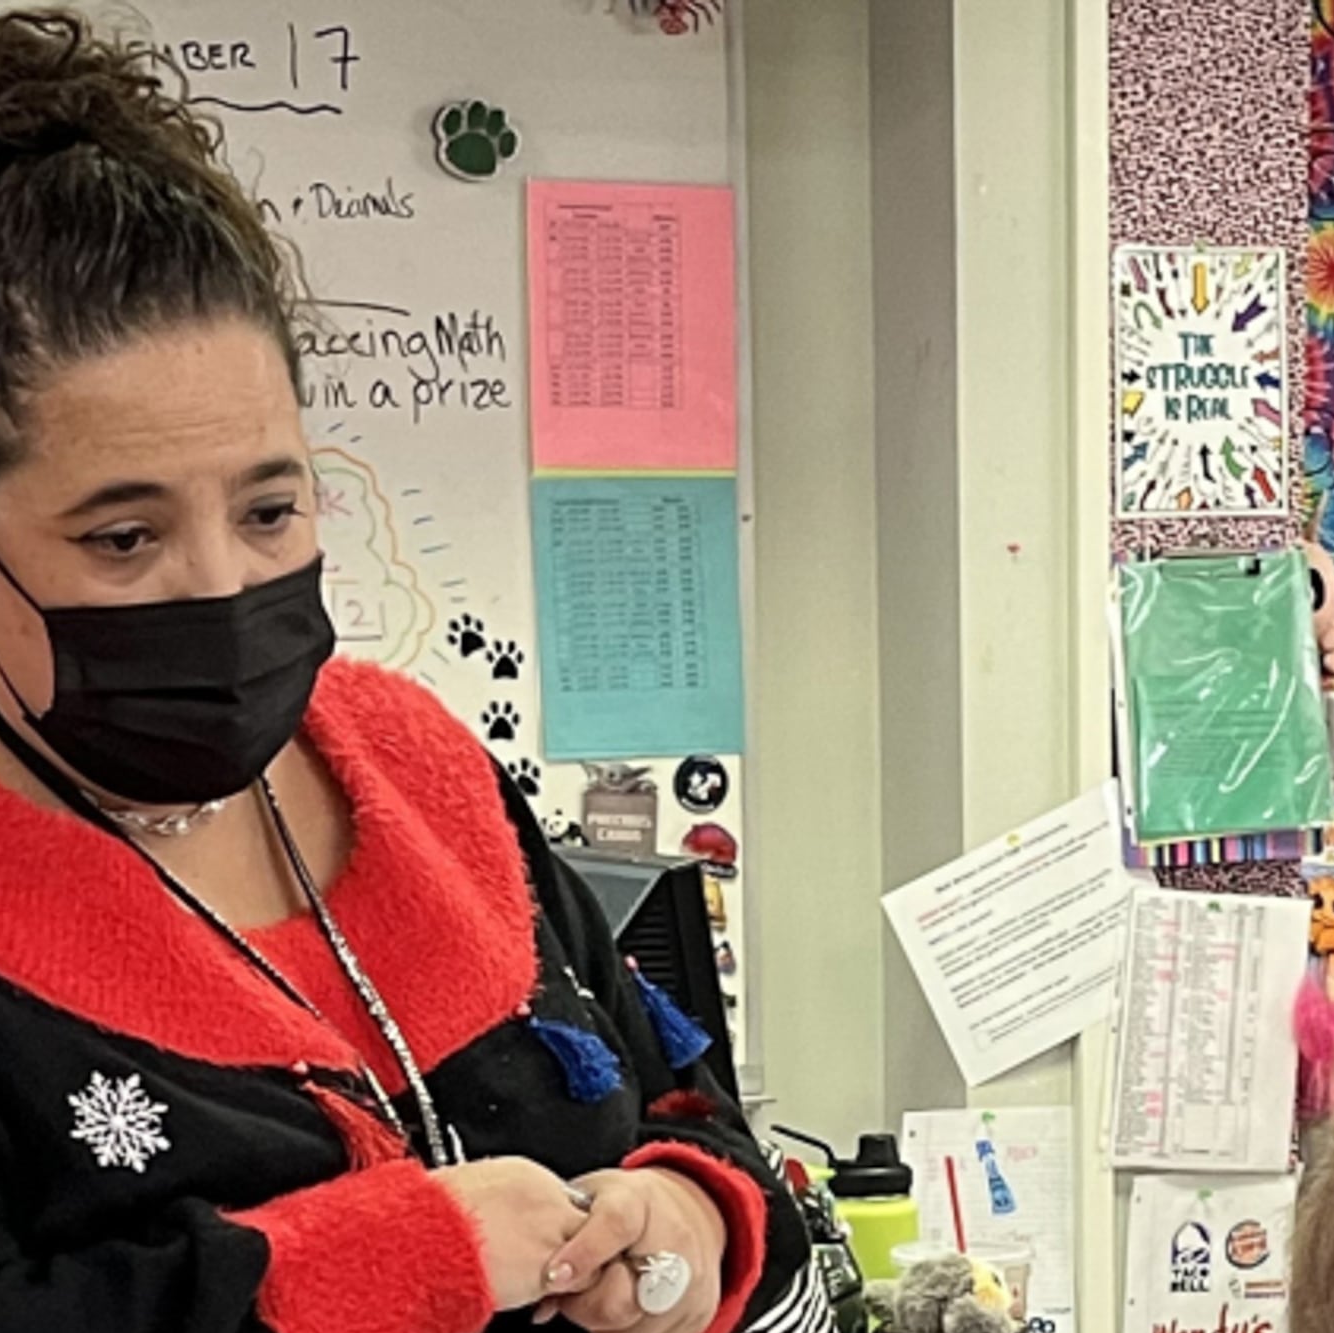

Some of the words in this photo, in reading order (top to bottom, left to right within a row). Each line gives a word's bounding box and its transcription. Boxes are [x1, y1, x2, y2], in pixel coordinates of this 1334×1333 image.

[288, 22, 360, 91] 17
[1178, 332, 1215, 360] THE
[1146, 363, 1250, 392] STRUGGLE
[369, 379, 401, 409] a
[412, 377, 512, 425] prize
[1165, 395, 1181, 421] IS
[1187, 394, 1233, 423] REAL
